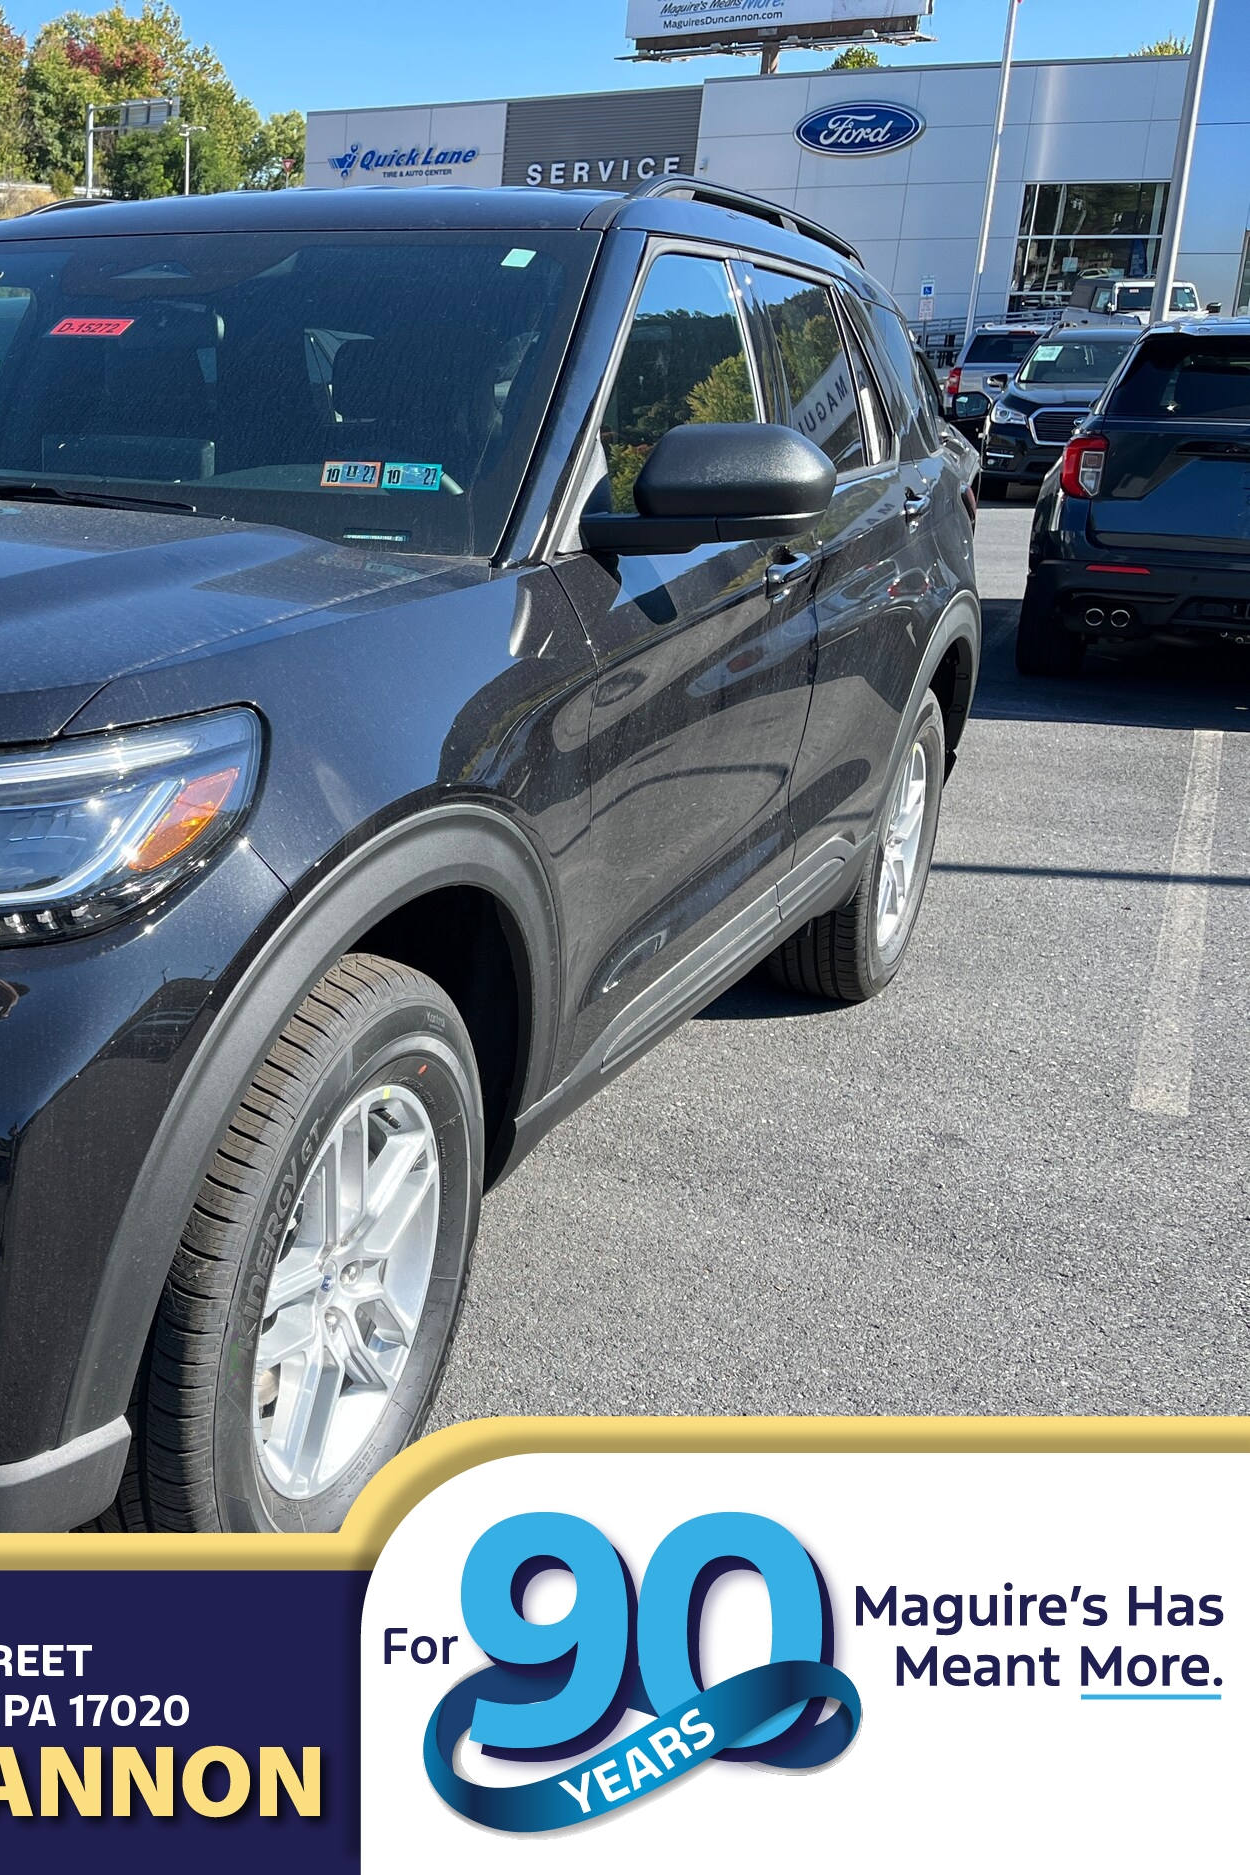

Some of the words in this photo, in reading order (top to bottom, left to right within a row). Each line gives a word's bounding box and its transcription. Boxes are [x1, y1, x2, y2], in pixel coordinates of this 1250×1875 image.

[660, 0, 708, 17] Maguire's
[663, 11, 783, 30] MaguiresDuncannon.com
[819, 114, 894, 145] Ford
[359, 148, 420, 171] Quick
[421, 145, 477, 166] Lane
[425, 168, 452, 176] CENTER
[525, 156, 681, 186] SERVICE
[56, 322, 121, 334] D-15272
[326, 468, 341, 483] 10
[362, 465, 377, 484] 27
[386, 469, 402, 484] 10
[423, 467, 438, 486] 27
[301, 1117, 321, 1167] GT
